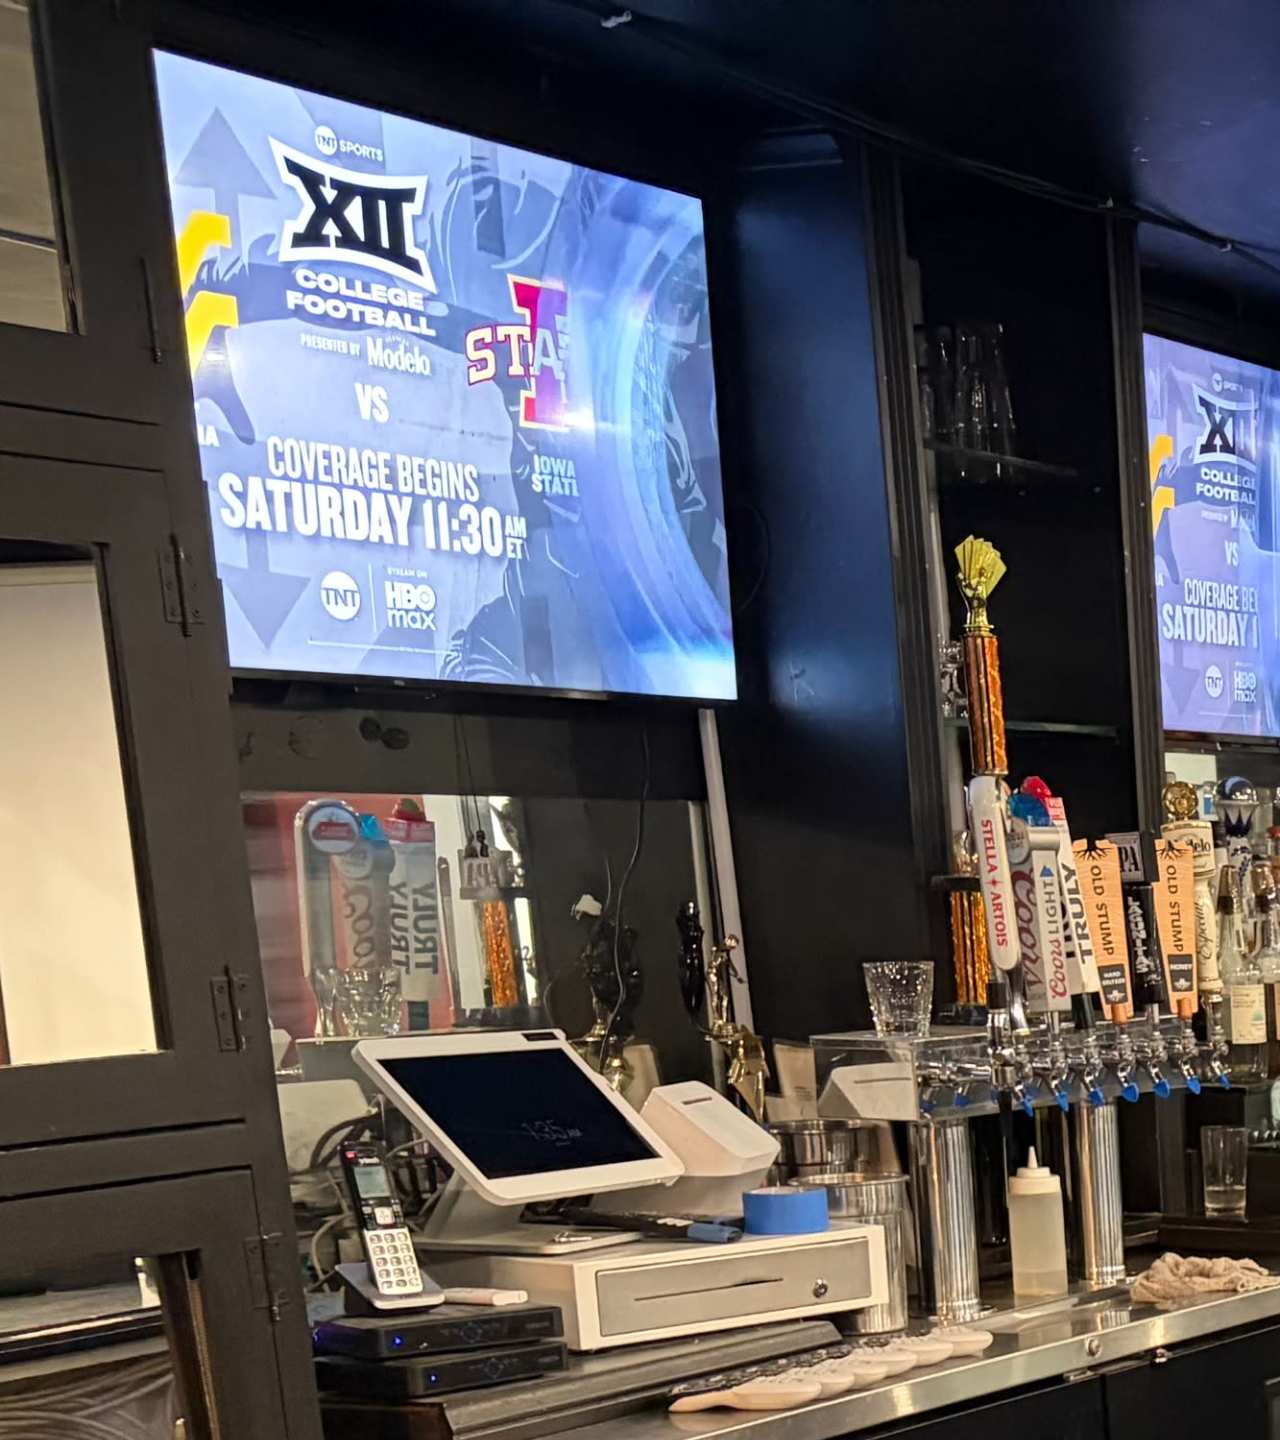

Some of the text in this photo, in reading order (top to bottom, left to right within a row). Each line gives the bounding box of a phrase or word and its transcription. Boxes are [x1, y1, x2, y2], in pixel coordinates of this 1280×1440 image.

[339, 139, 384, 162] SPORTS
[282, 155, 425, 278] XII
[295, 267, 425, 312] COLLEGE
[286, 289, 437, 337] FOOTBALL
[366, 336, 432, 377] Modelo
[354, 382, 390, 424] VS
[267, 435, 391, 492] COVERAGE
[399, 453, 480, 503] BEGINS
[533, 454, 576, 478] IOWA
[218, 472, 527, 558] SATURDAY 11:30 AM
[505, 537, 525, 560] ET
[1225, 540, 1240, 567] VS
[320, 587, 361, 606] TNT
[384, 580, 436, 612] HBO
[1184, 578, 1241, 611] COVERAGE
[386, 608, 437, 631] max
[1162, 603, 1250, 647] SATURDAY
[981, 818, 1009, 948] STELLA ARTOIS
[1061, 862, 1094, 965] TRULY
[1090, 864, 1115, 957] OLD STUMP
[1166, 864, 1185, 953] OLD STUMP
[1043, 879, 1068, 999] Coors LIGHT
